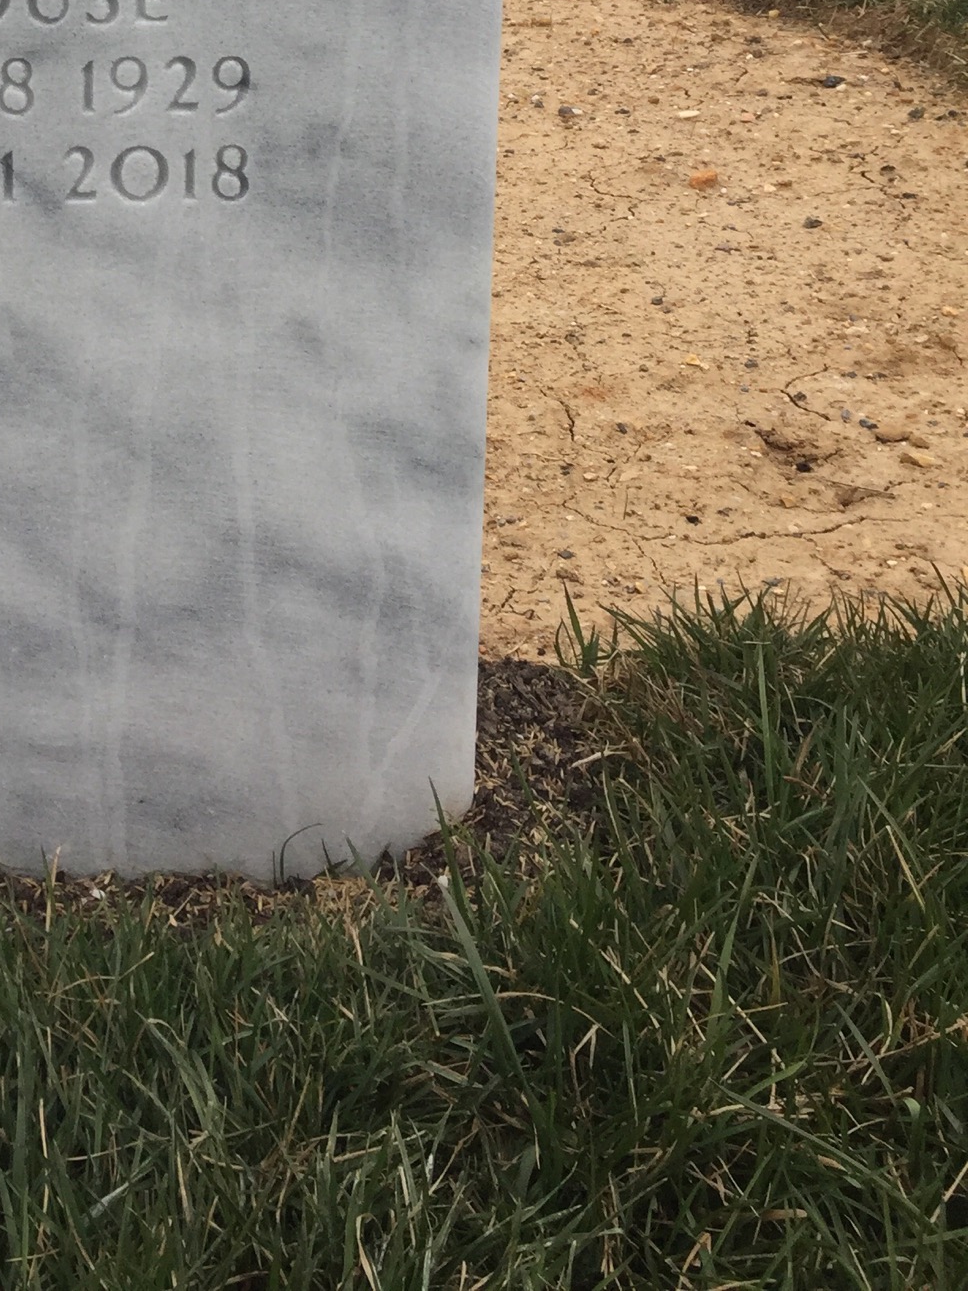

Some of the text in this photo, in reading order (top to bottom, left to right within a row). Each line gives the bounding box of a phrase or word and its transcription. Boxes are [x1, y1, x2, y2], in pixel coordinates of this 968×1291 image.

[81, 56, 251, 115] 1929
[1, 150, 16, 202] 1
[63, 145, 250, 203] 2018
